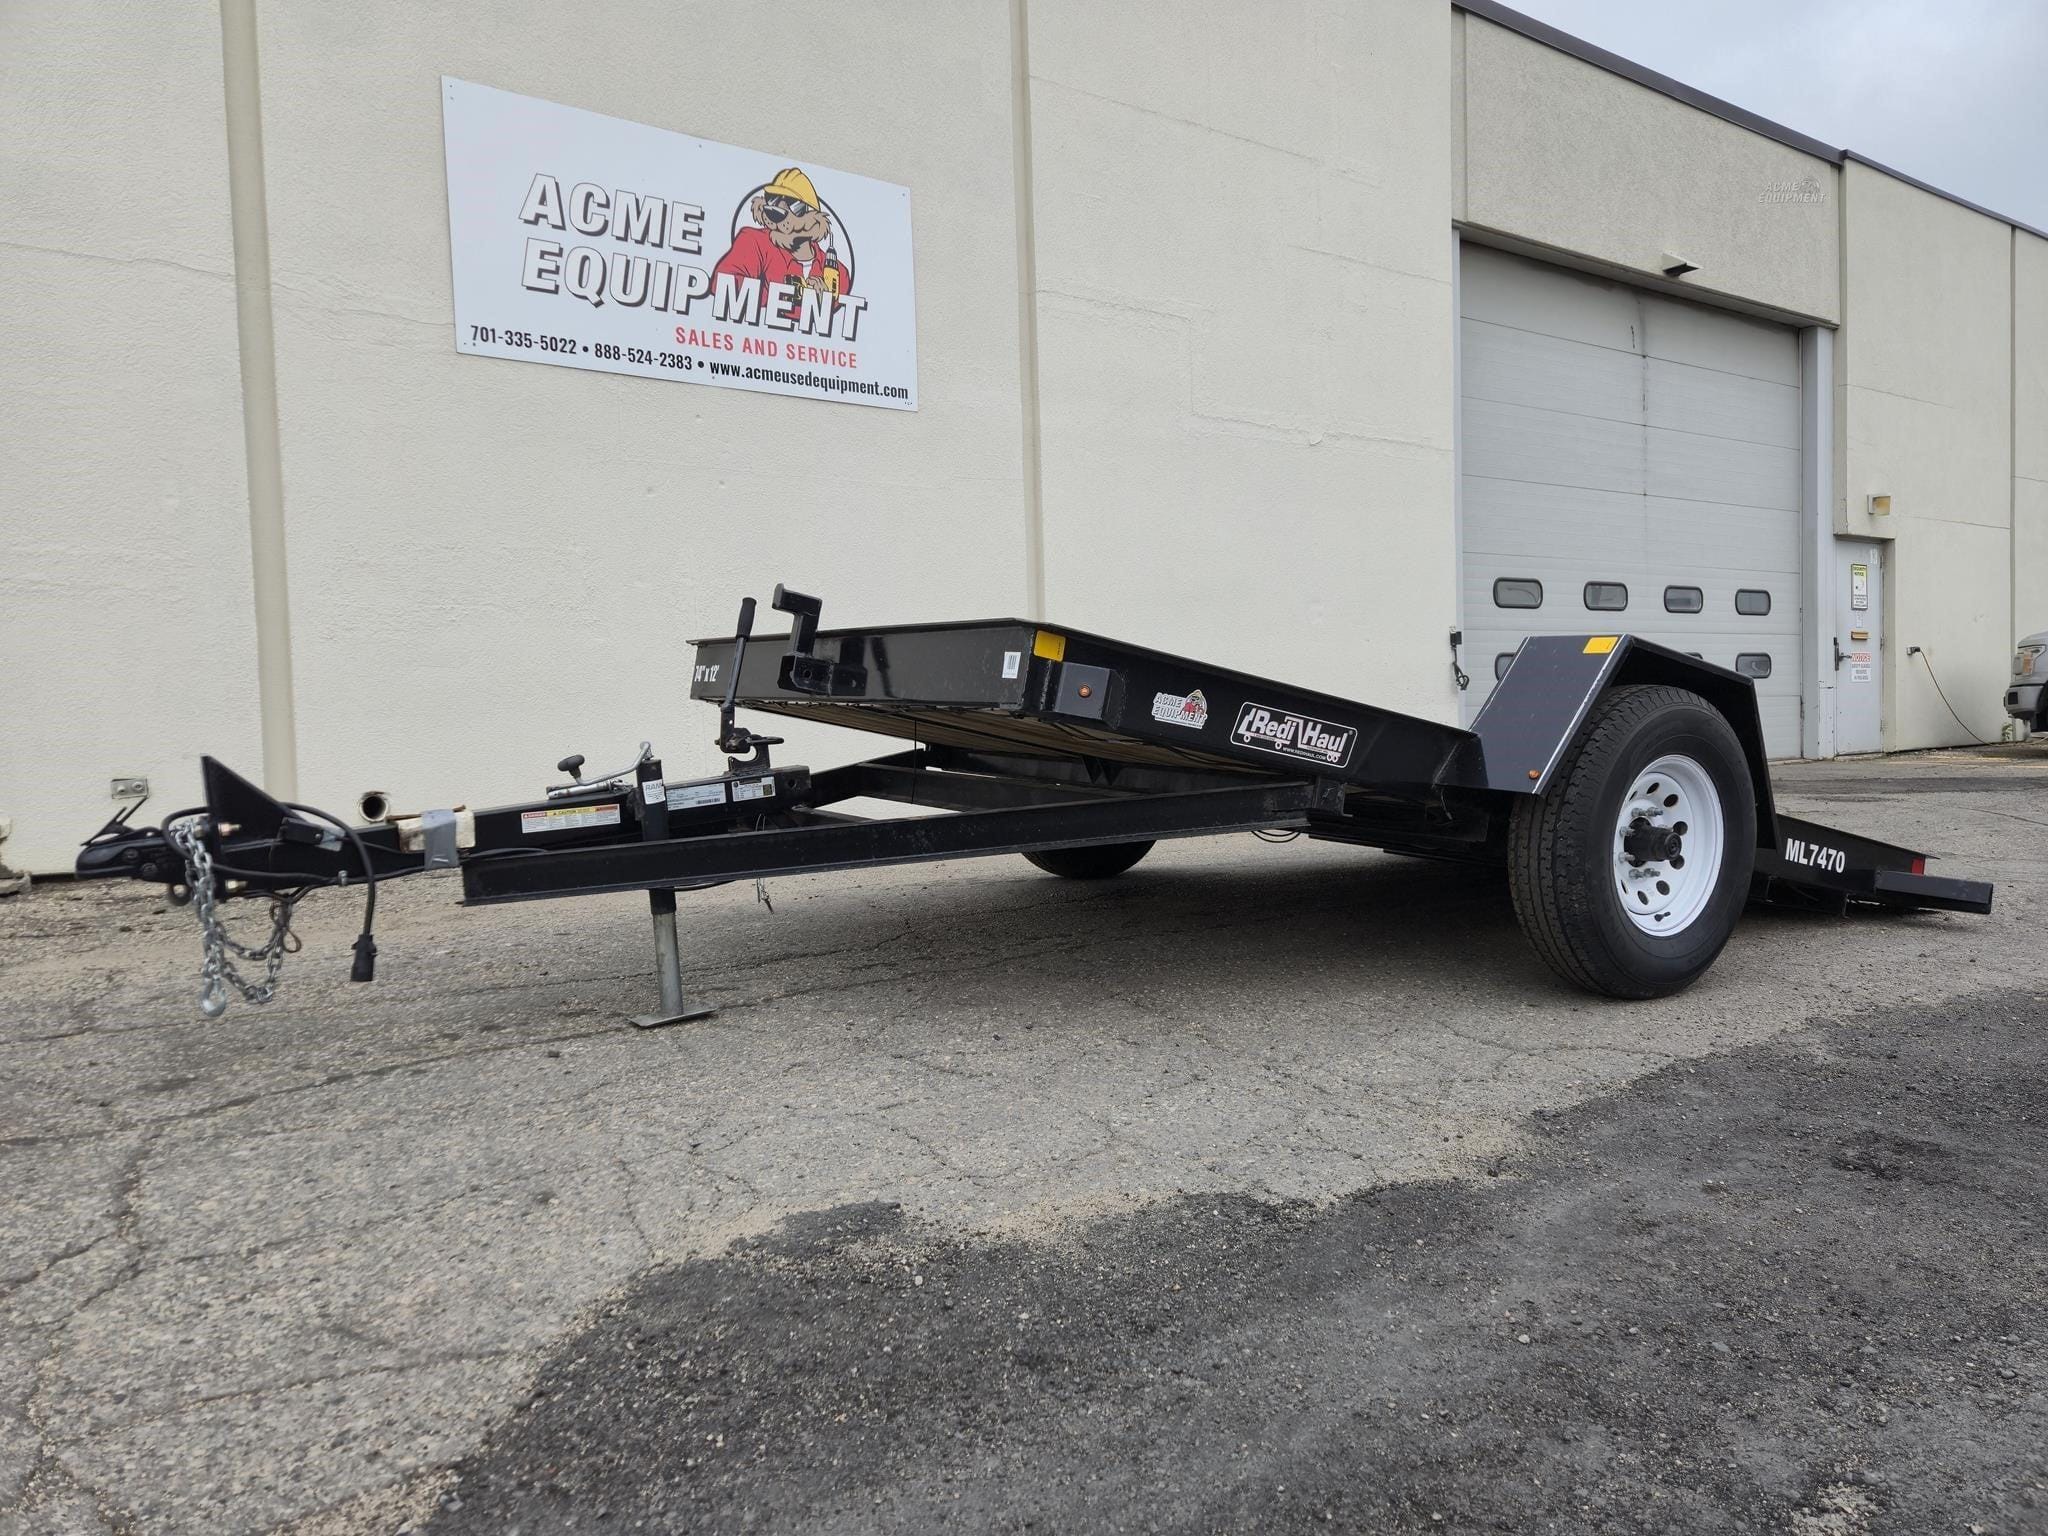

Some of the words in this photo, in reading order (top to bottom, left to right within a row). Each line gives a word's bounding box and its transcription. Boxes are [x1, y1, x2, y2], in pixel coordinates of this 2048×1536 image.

[519, 173, 706, 255] ACME
[521, 237, 868, 341] EQUIPMENT
[470, 324, 577, 355] 701-335-5022
[594, 342, 693, 370] 888-524-2383
[709, 360, 909, 400] www.acmeusedequipment.com
[675, 326, 734, 351] SALES
[742, 336, 778, 357] AND
[786, 343, 857, 368] SERVICE
[1152, 705, 1207, 727] EQUIPMENT
[1154, 692, 1184, 708] ACME
[1250, 709, 1297, 741] Redi
[1302, 721, 1348, 752] Haul
[1785, 838, 1846, 873] ML7470
